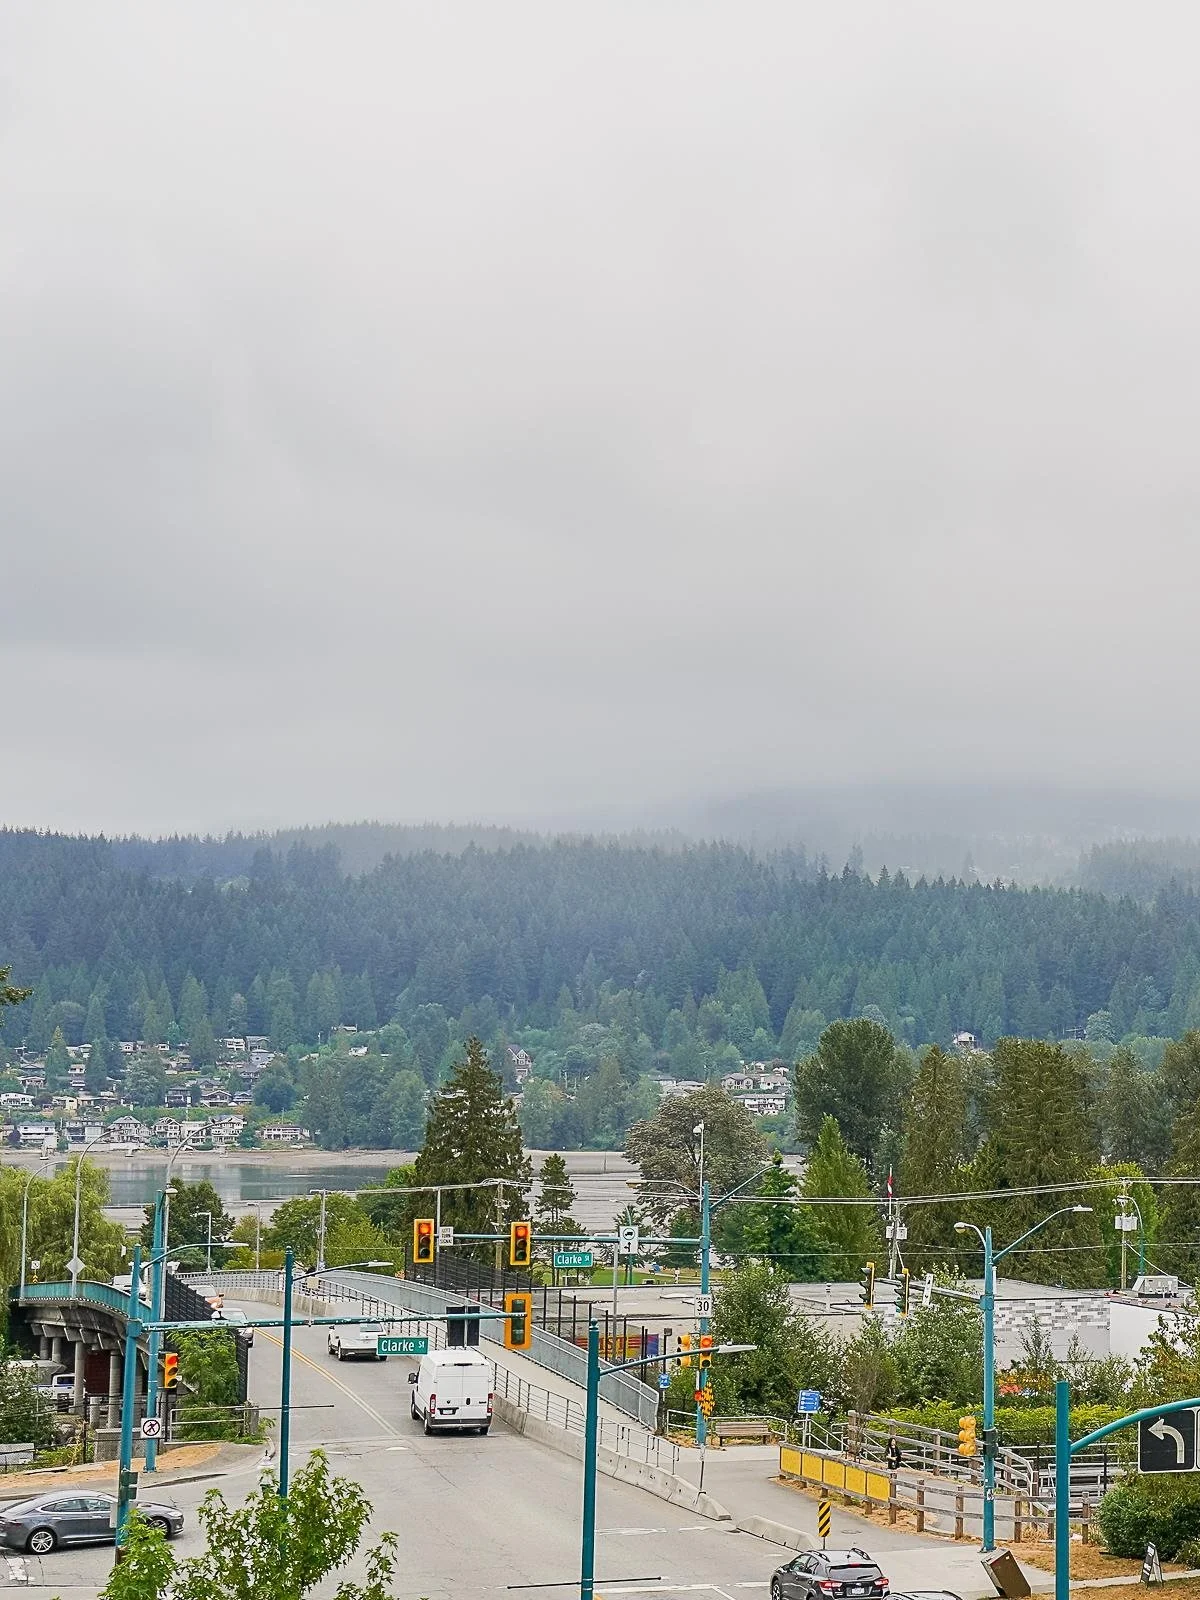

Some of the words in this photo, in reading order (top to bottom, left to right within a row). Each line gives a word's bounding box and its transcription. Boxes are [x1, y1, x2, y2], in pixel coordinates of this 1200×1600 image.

[557, 1254, 582, 1265] Clarke
[696, 1300, 710, 1312] 30
[381, 1339, 415, 1352] Clarke
[418, 1340, 425, 1349] St
